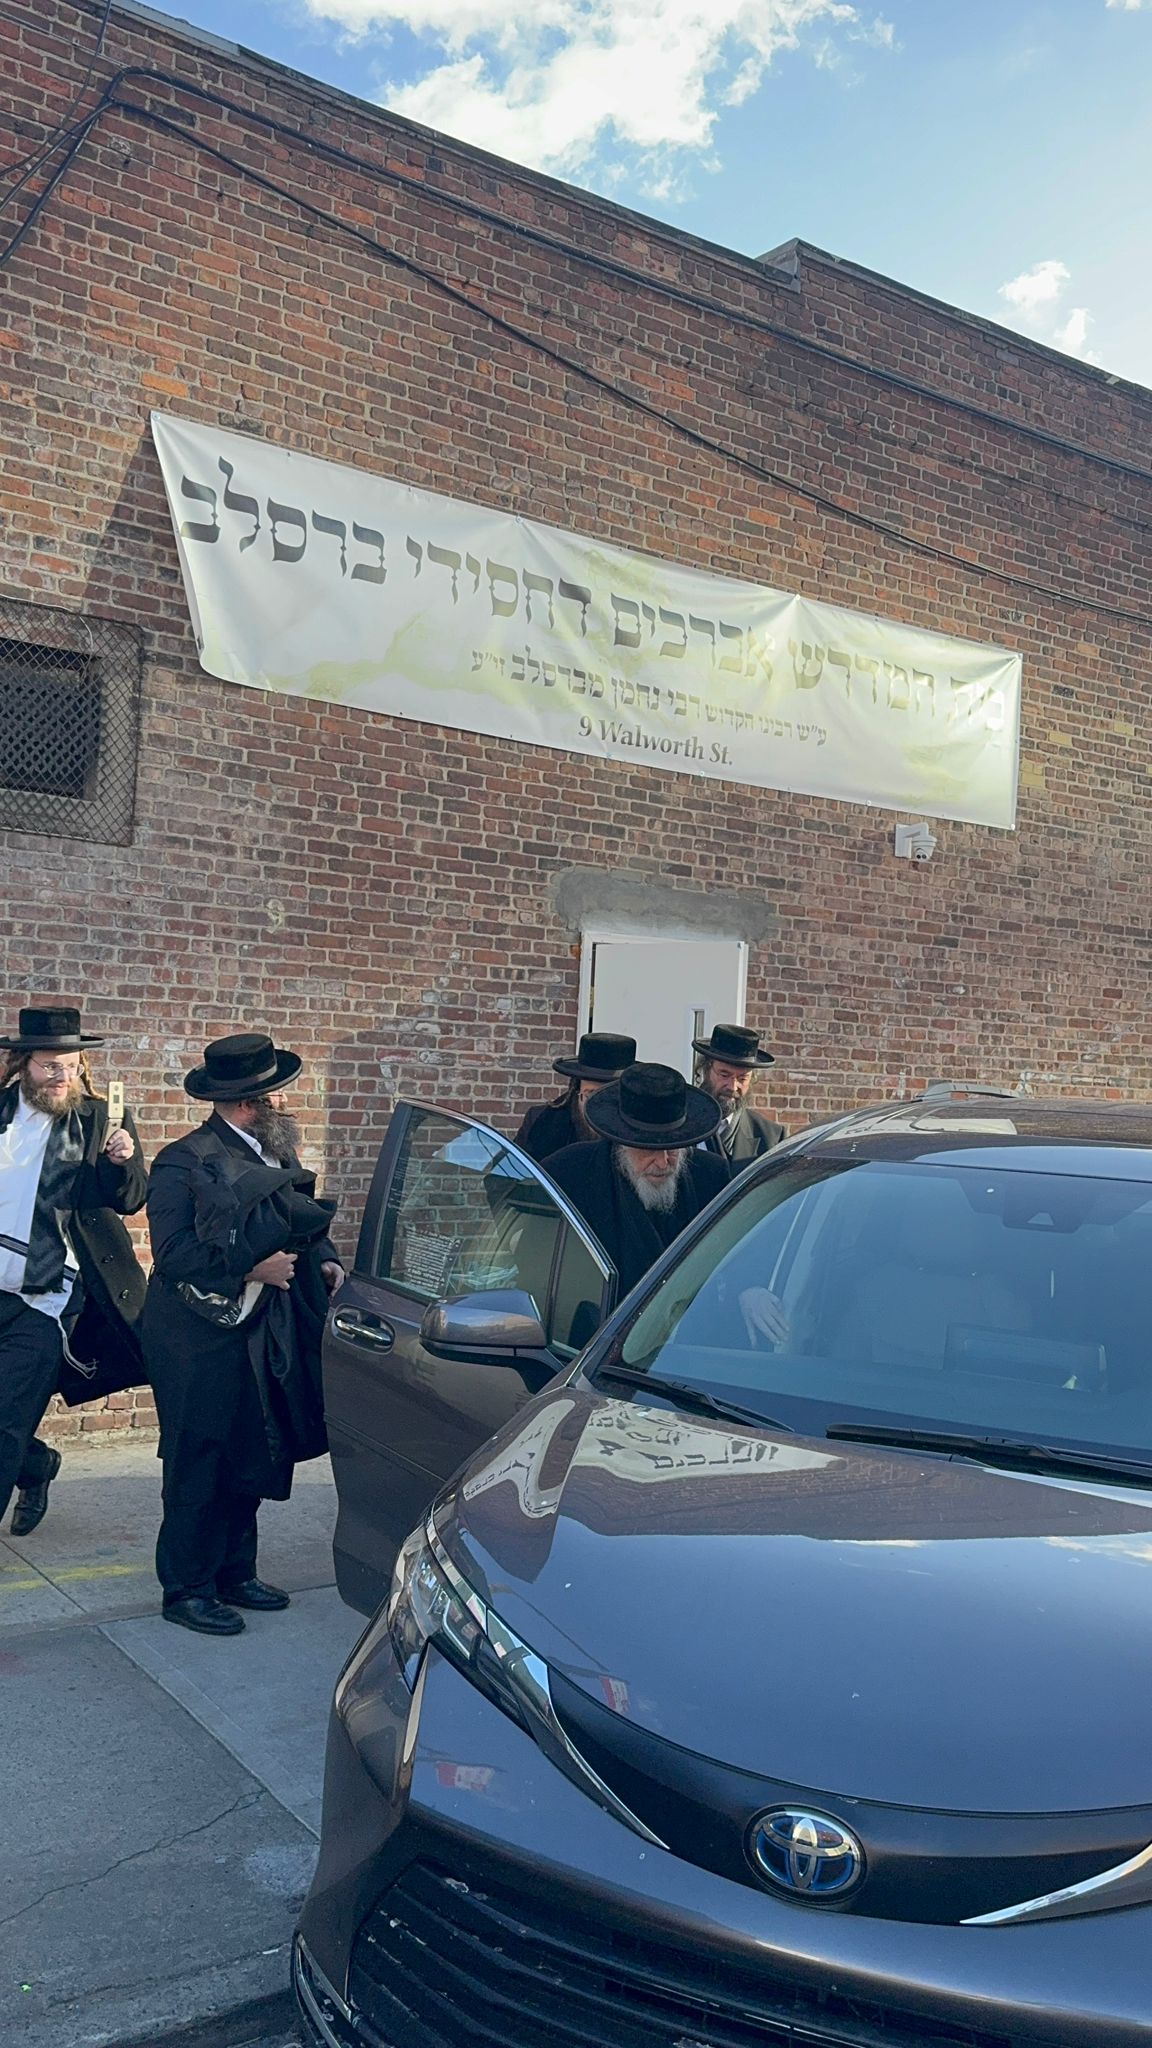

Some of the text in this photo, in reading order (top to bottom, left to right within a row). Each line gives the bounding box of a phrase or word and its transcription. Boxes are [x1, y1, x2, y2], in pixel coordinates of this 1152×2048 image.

[180, 455, 388, 585] ברסלב
[406, 535, 592, 638] דחסידי
[611, 592, 774, 684] אברכים
[510, 644, 604, 699] מברסלב
[611, 677, 660, 711] נחמן
[787, 636, 935, 718] המדרש
[667, 688, 701, 719] רבי
[705, 703, 754, 733] הקדוש
[758, 714, 793, 739] רבינו
[578, 715, 733, 766] 9 Walworth St.
